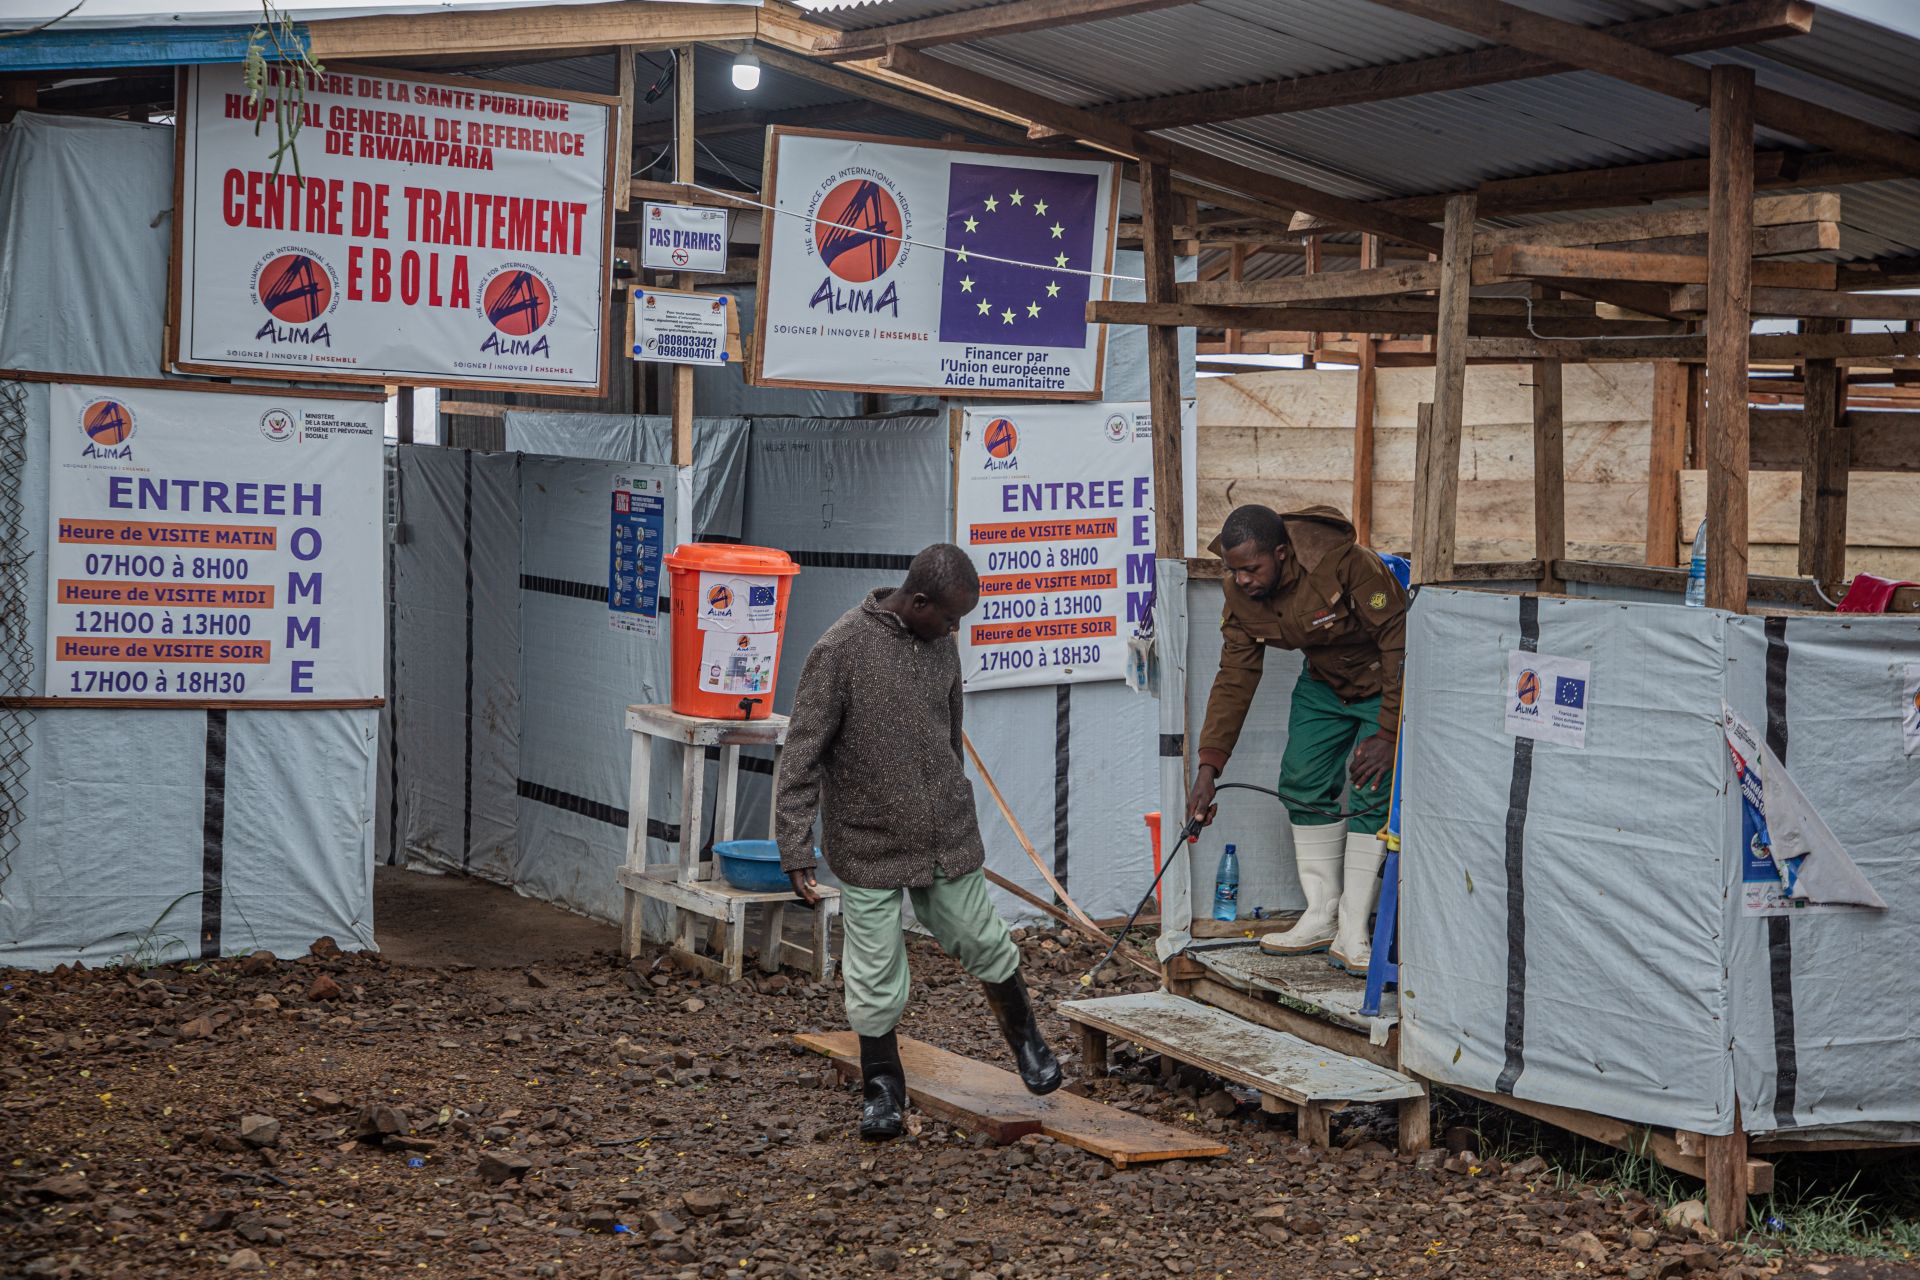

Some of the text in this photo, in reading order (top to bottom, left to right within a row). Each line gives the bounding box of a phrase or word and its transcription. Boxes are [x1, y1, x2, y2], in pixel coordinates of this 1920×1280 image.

[358, 78, 383, 99] DE
[387, 82, 410, 103] LA
[414, 85, 475, 112] SANTE
[479, 94, 569, 122] PUBLIQUE
[329, 105, 429, 141] GENERAL
[434, 118, 462, 144] DE
[467, 122, 585, 157] REFERENCE
[325, 130, 494, 171] DE RWAMPARA
[223, 168, 588, 256] CENTRE DE TRAITEMENT
[805, 238, 815, 256] THE
[821, 175, 837, 191] FOR
[838, 166, 897, 192] INTERNATIONAL
[896, 191, 913, 230] MEDICAL
[649, 228, 721, 252] PAS D'ARMES
[249, 245, 341, 315] THE ALLIANCE FOR INTERNATIONAL MEDICAL ACTION
[347, 245, 471, 309] EBOLA
[488, 267, 499, 277] FOR
[500, 262, 544, 278] INTERNATIONAL
[808, 276, 900, 318] ALIMA
[255, 318, 332, 348] ALIMA
[658, 334, 717, 349] 0808033421
[774, 325, 929, 341] SOIGNER INNOVER ENSEMBLE
[480, 331, 550, 359] ALIMA
[657, 345, 715, 359] 0988904701
[965, 347, 1049, 364] Financer par
[226, 350, 357, 363] SOIGNER INNOVER ENSEMBLE
[941, 359, 1071, 377] l'Union européenne
[945, 373, 1065, 389] Aide humanitaitre
[82, 442, 133, 461] ALIMA
[984, 456, 1018, 471] ALIMA
[109, 476, 286, 516] ENTREE
[1003, 480, 1124, 513] ENTREE
[59, 524, 274, 545] Heure de VISITE MATIN
[970, 522, 1115, 541] Heure de VISITE MATIN
[172, 554, 184, 578] à
[1046, 547, 1055, 568] à
[1126, 477, 1156, 637] FEMM
[979, 573, 1112, 593] Heure de VISITE MIDI
[66, 585, 266, 604] Heure de VISITE MIDI
[1040, 596, 1049, 616] à
[161, 610, 174, 635] à
[976, 621, 1112, 641] Heure de VISITE SOIR
[65, 642, 264, 659] Heure de VISITE SOIR
[1039, 647, 1047, 667] à
[1053, 645, 1100, 666] 18H30
[155, 669, 167, 693] à
[176, 671, 245, 694] 18H30
